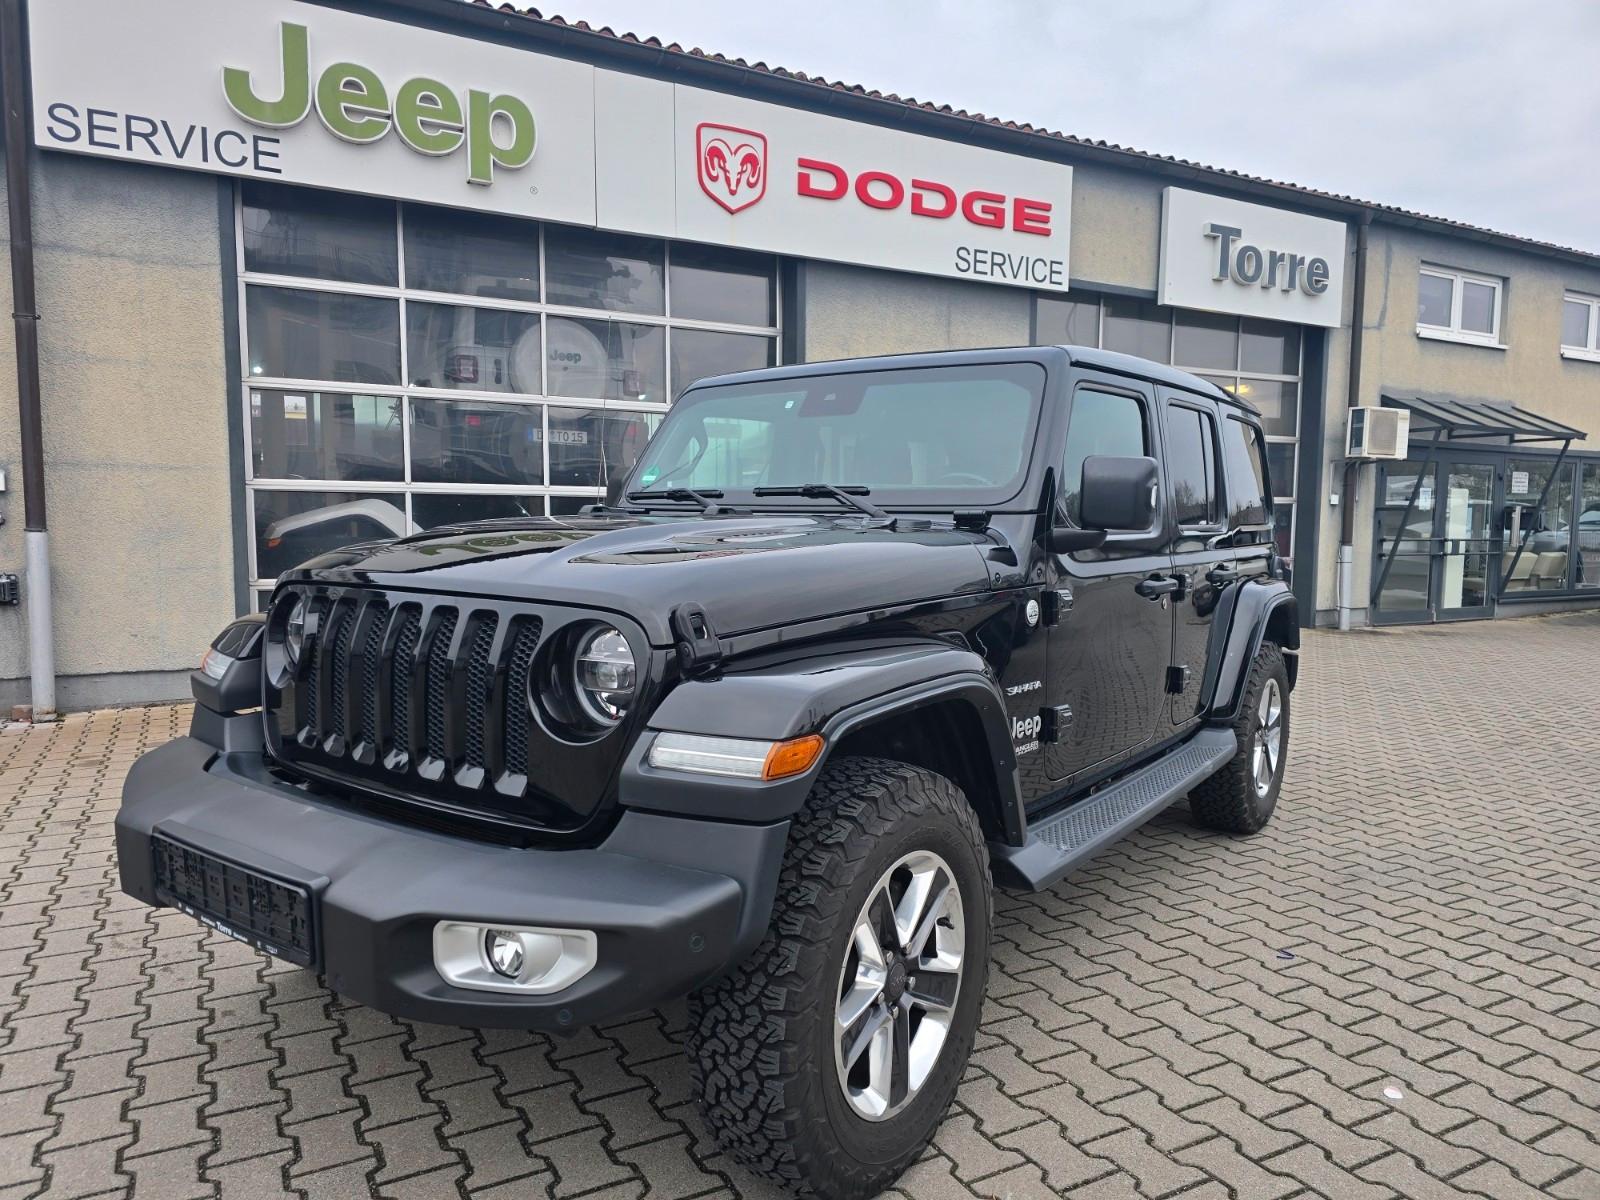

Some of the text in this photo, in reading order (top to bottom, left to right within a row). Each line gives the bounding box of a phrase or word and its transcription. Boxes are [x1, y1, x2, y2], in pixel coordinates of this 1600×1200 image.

[221, 21, 537, 186] Jeep
[47, 103, 282, 174] SERVICE
[797, 157, 1052, 237] DODGE
[955, 246, 1064, 286] SERVICE
[1204, 222, 1329, 296] Torre
[549, 350, 582, 364] Jeep
[571, 432, 584, 442] 15
[1005, 680, 1042, 696] SAHARA
[1011, 715, 1042, 739] Jeep
